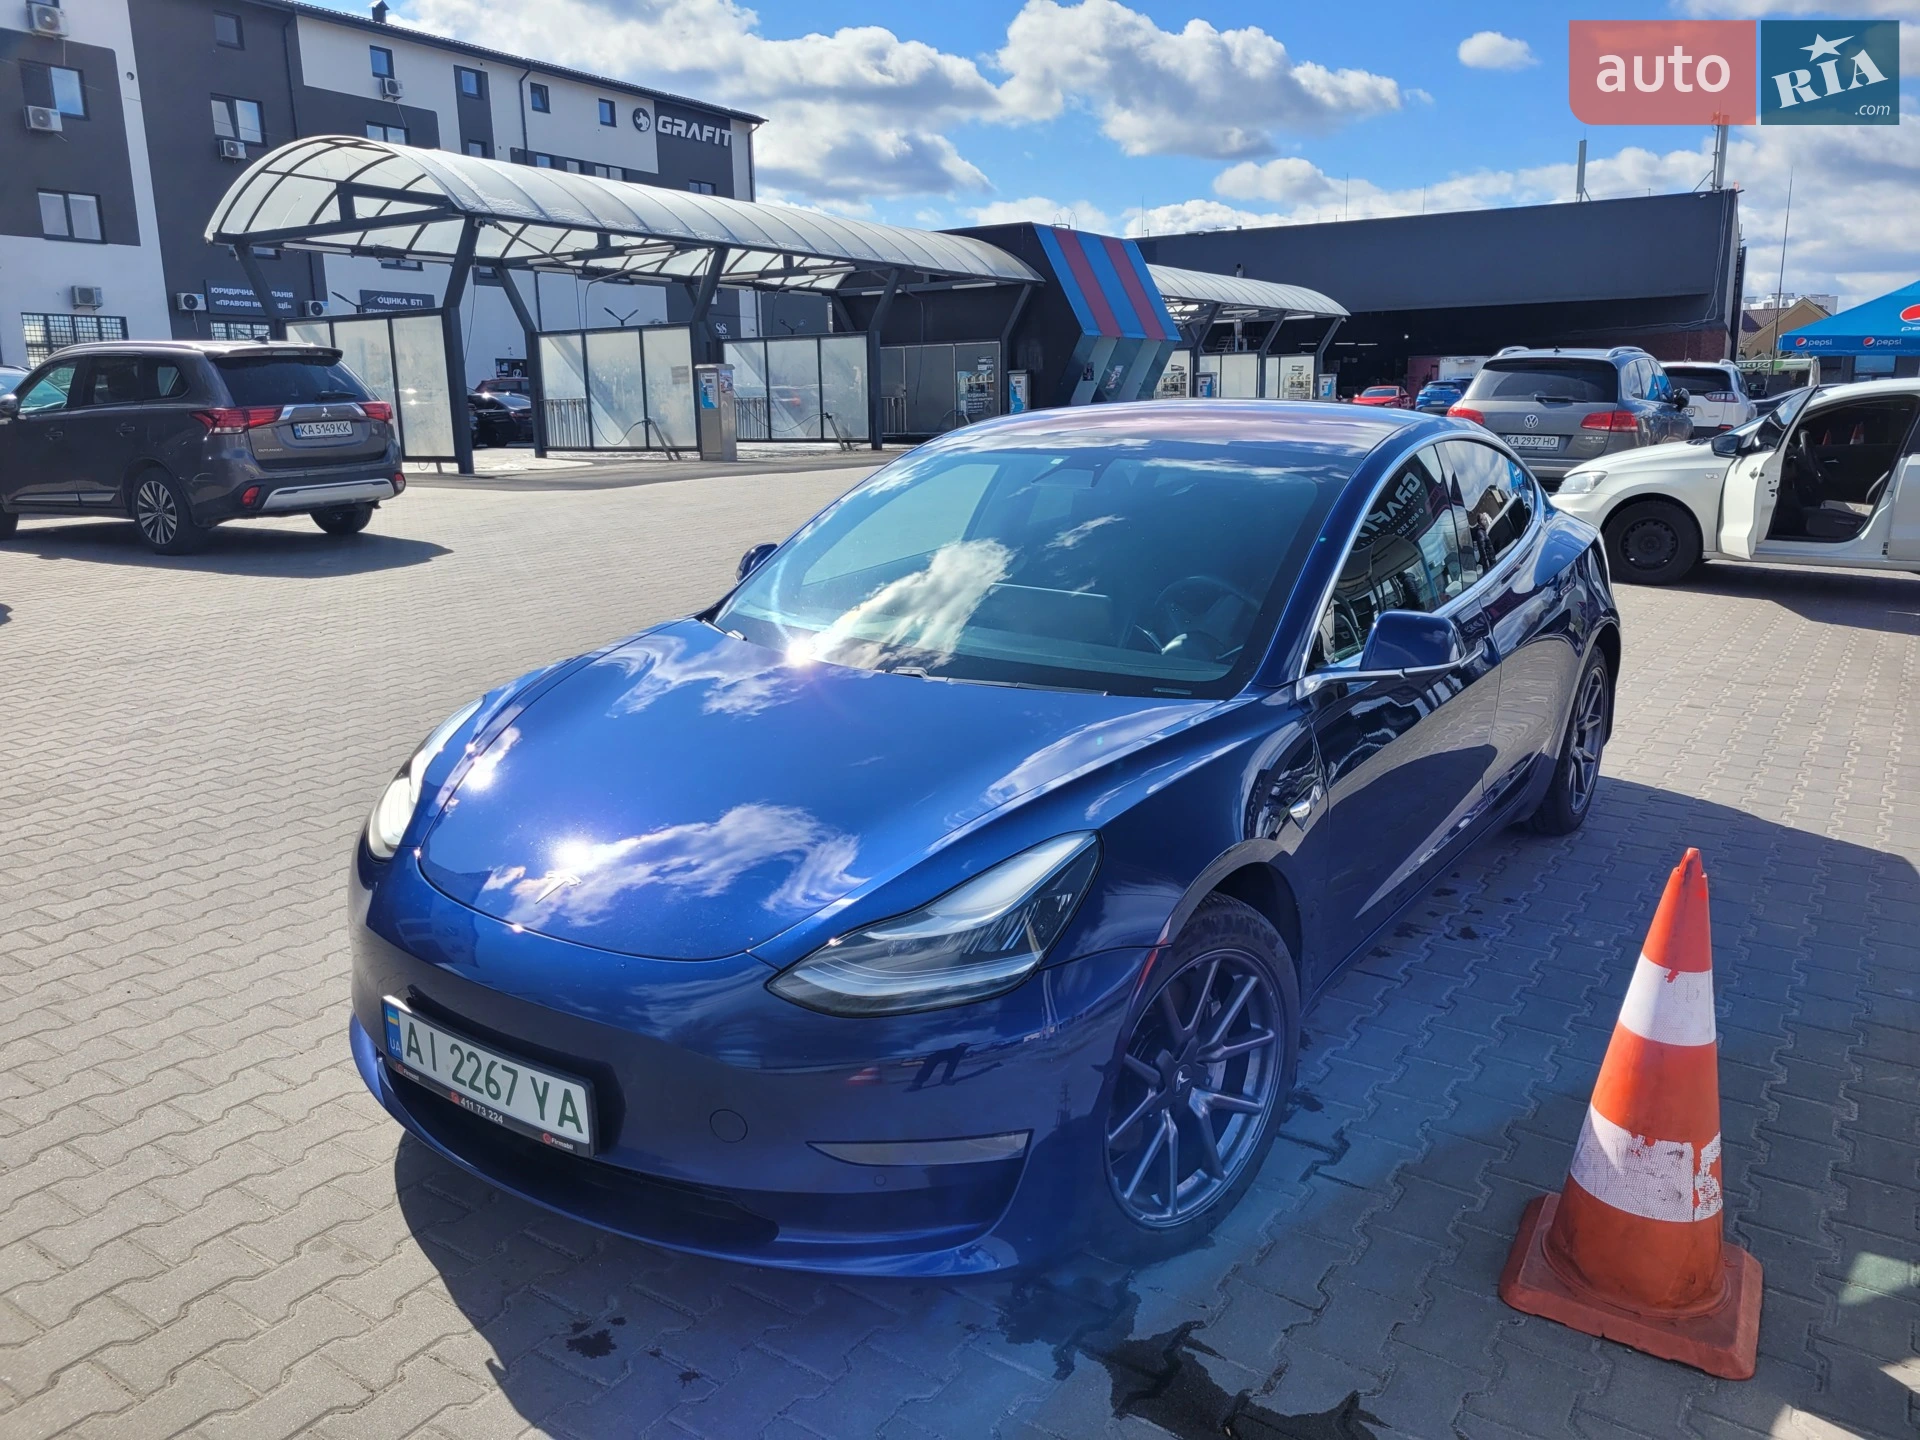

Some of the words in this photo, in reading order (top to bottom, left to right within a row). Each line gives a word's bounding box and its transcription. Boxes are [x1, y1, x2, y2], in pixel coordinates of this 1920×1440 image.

[657, 115, 733, 147] GRAFIT
[210, 287, 255, 296] ЮРИДИЧНА
[269, 290, 294, 298] ПАНІЯ
[377, 296, 408, 306] ОЦІНКА
[410, 298, 423, 307] БТІ
[1807, 338, 1833, 347] pepsi
[1876, 338, 1902, 347] pepsi
[300, 424, 315, 436] KA
[316, 423, 335, 434] 5149
[337, 422, 351, 433] KK
[1507, 436, 1519, 445] KA
[1521, 436, 1541, 446] 2937
[1543, 437, 1556, 446] HO
[389, 1037, 402, 1054] UA
[406, 1022, 437, 1072] AI
[450, 1044, 518, 1106] 2267
[530, 1076, 583, 1134] YA
[460, 1098, 475, 1111] 411
[476, 1104, 486, 1116] 73
[488, 1110, 503, 1125] 224
